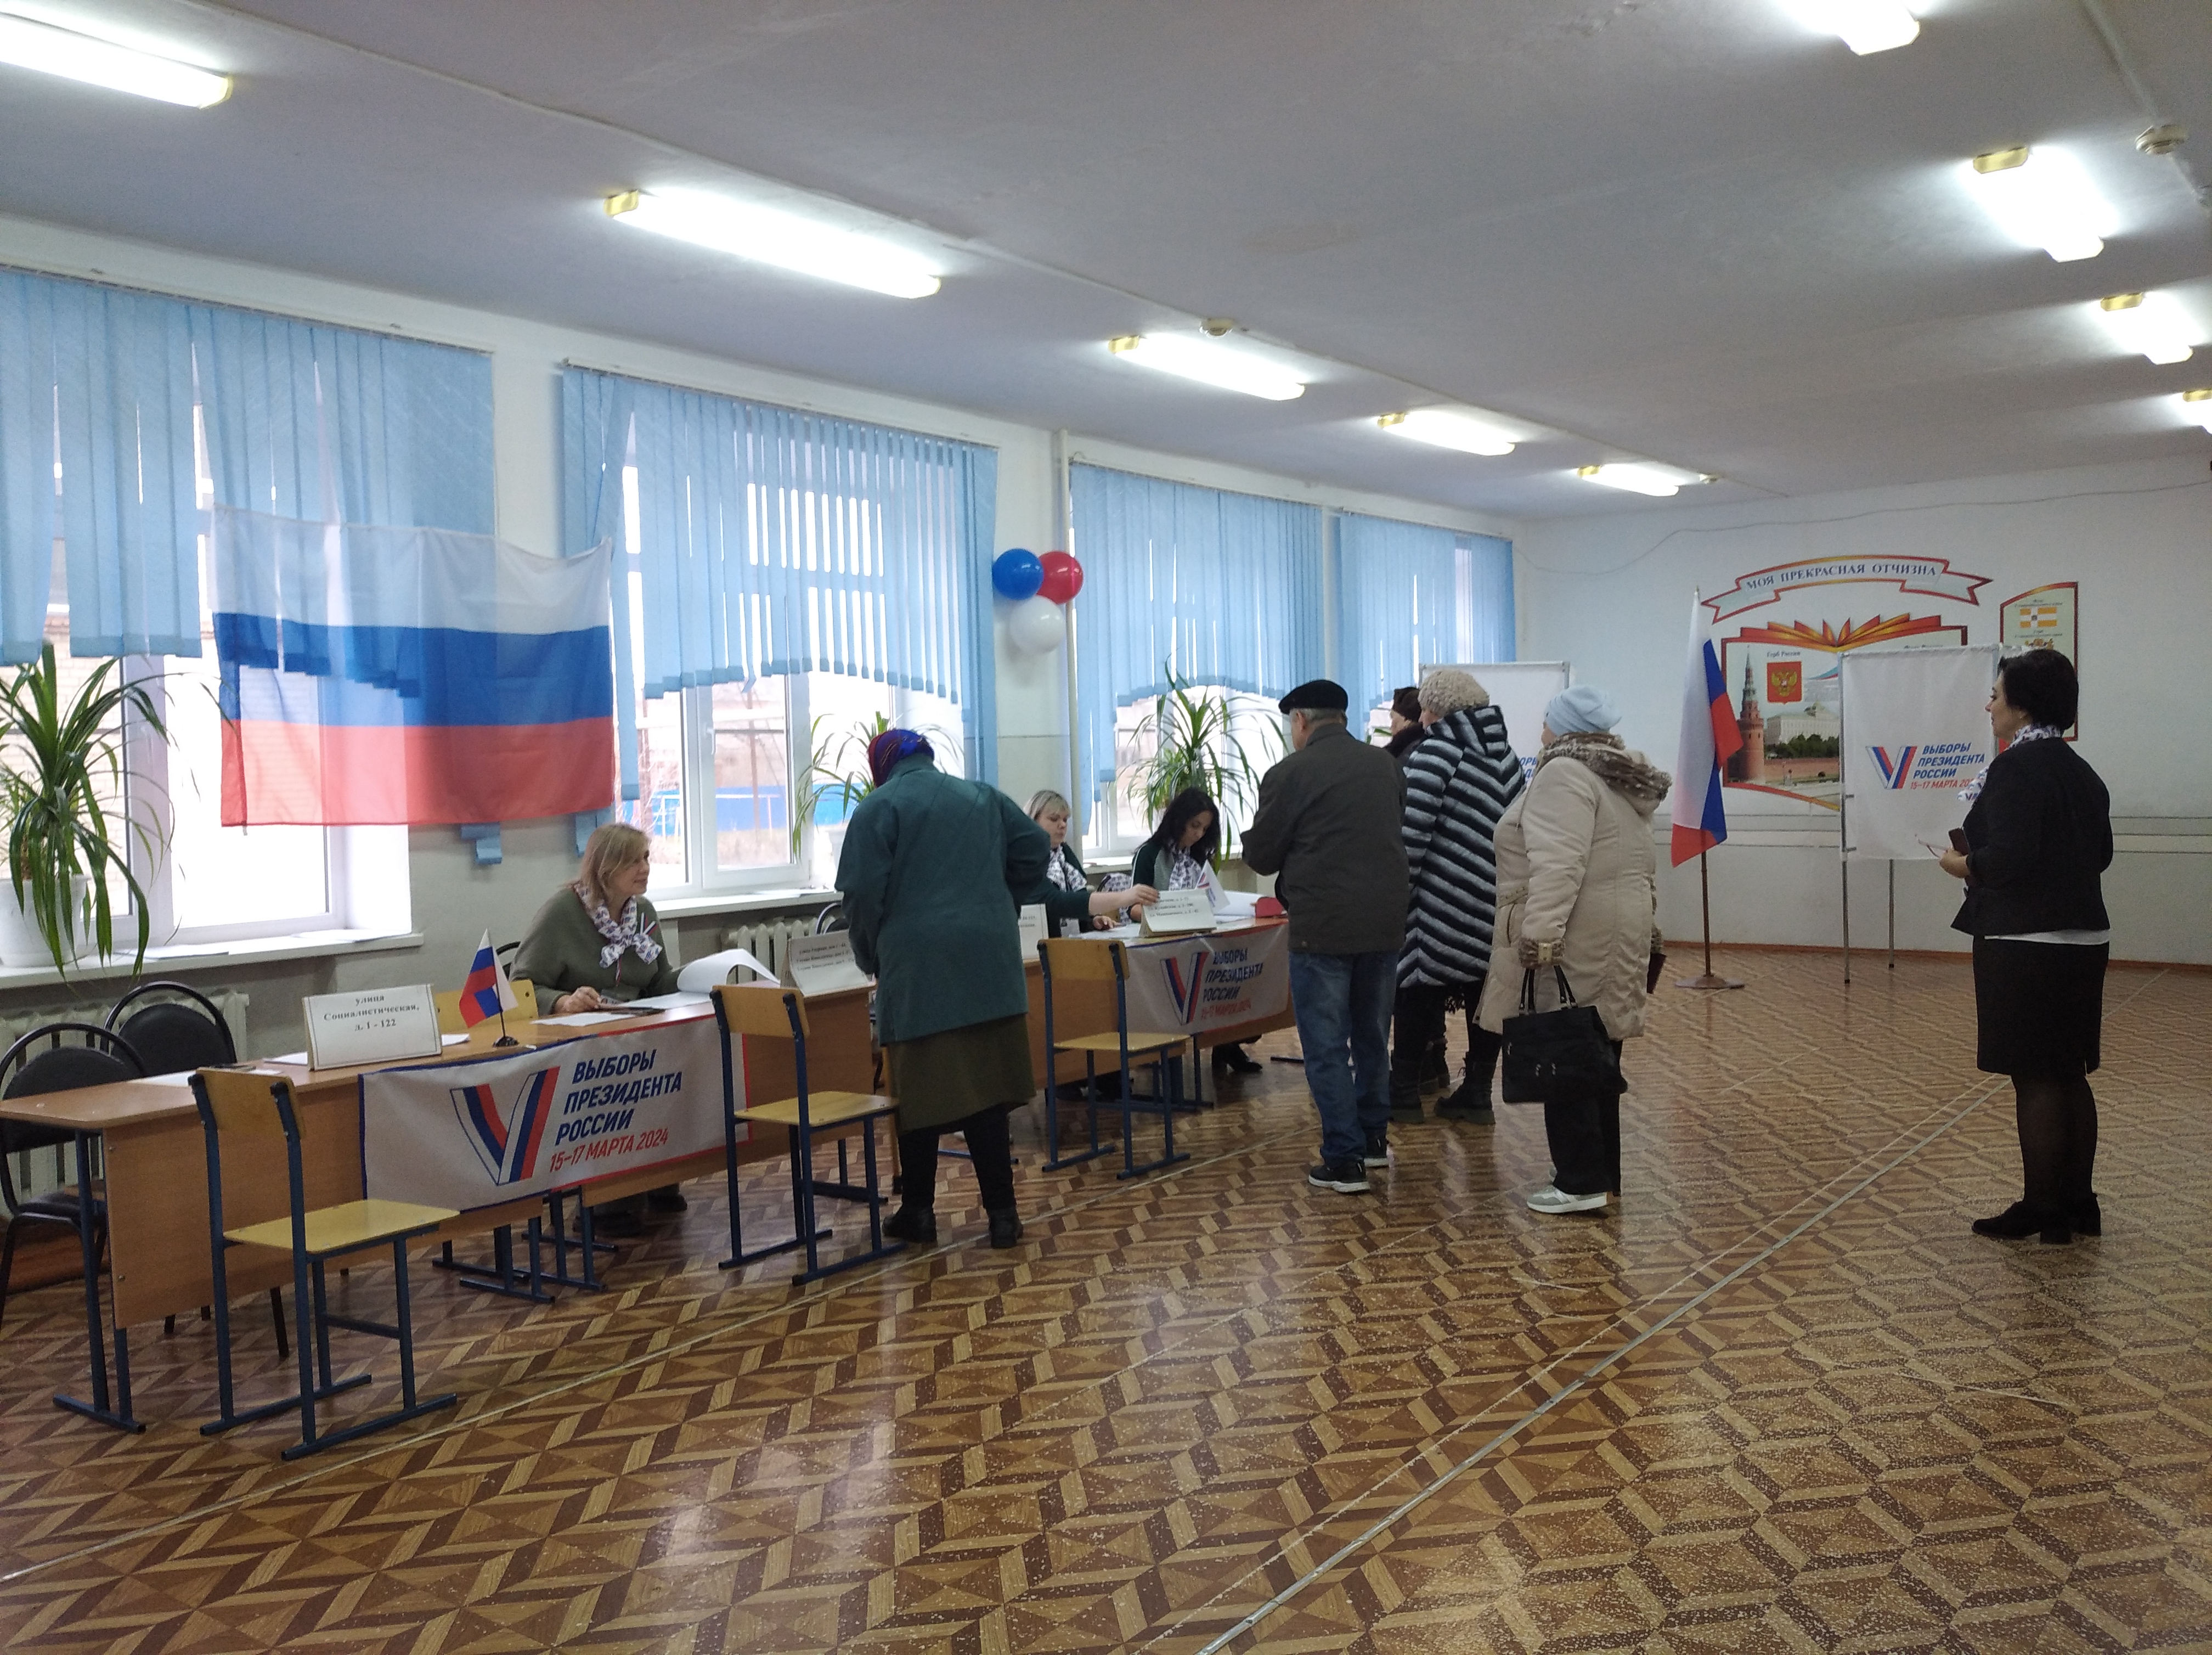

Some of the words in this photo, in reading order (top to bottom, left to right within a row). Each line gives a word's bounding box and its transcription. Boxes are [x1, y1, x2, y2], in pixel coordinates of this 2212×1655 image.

[1746, 575, 1775, 590] МОЯ
[1780, 564, 1865, 582] ПРЕКРАСНАЯ
[1872, 564, 1936, 575] ОТЧИЗНА
[1922, 742, 1972, 755] ВЫБОРЫ
[1917, 753, 1985, 767] ПРЕЗИДЕНТА
[1913, 768, 1957, 779] РОССИИ
[1931, 779, 1957, 789] МАРТА
[1212, 947, 1248, 965] ВЫБОРЫ
[355, 995, 385, 1006] улица
[1203, 986, 1241, 1003] РОССИИ
[381, 1018, 397, 1028] 122
[572, 1049, 657, 1085] ВЫБОРЫ
[563, 1071, 682, 1115] ПРЕЗИДЕНТА
[555, 1108, 635, 1146] РОССИИ
[585, 1134, 635, 1162] МАРТА
[636, 1128, 669, 1151] 2024
